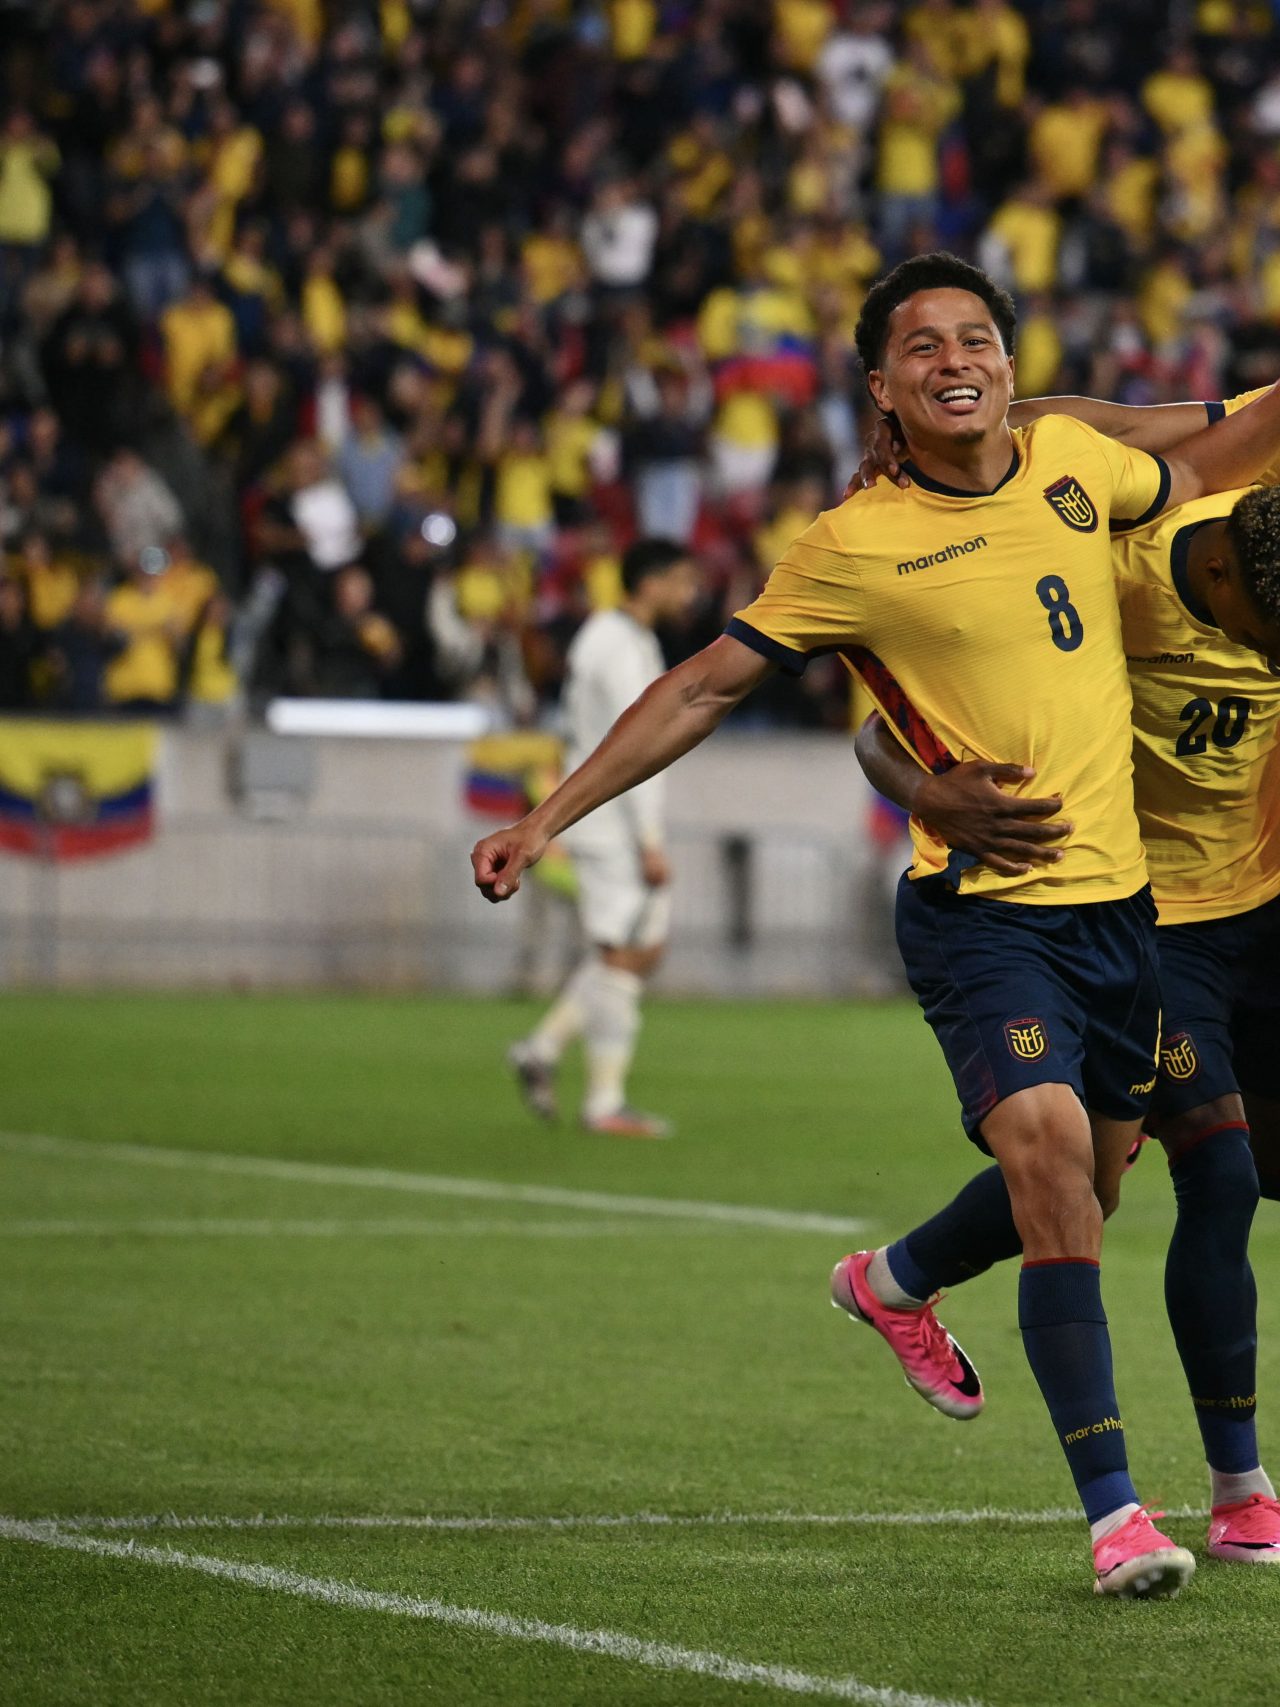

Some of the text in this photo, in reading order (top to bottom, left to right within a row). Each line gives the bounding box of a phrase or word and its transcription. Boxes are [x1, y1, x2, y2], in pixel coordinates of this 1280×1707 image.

[897, 535, 988, 575] marathon
[1035, 574, 1084, 652] 8
[1175, 697, 1250, 757] 20
[1065, 1416, 1123, 1445] maratho
